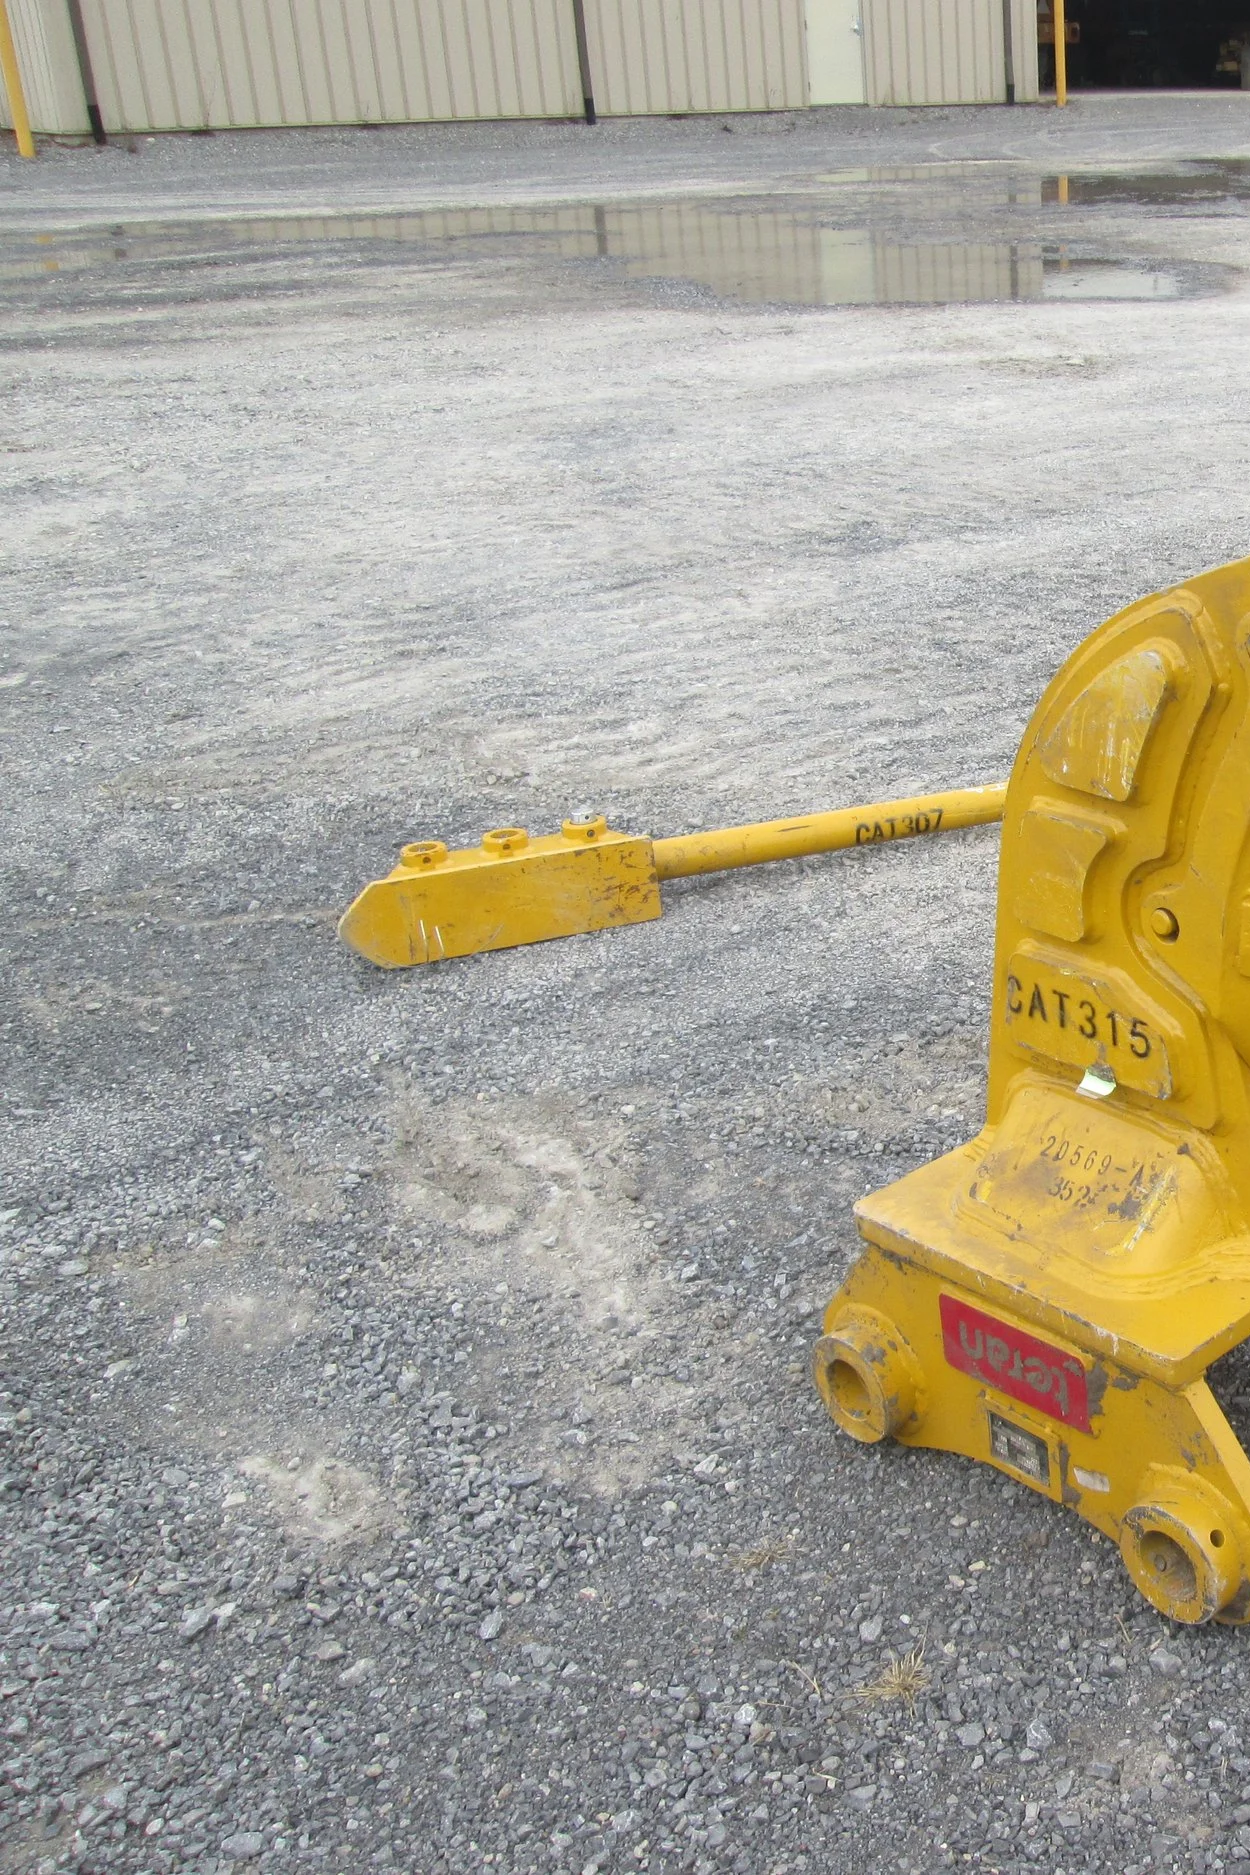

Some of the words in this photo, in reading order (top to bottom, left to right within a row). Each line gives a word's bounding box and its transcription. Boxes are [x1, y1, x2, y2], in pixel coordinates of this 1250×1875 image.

[855, 808, 944, 843] CAT307
[1007, 975, 1151, 1059] CAT315
[959, 1320, 1069, 1416] teran
